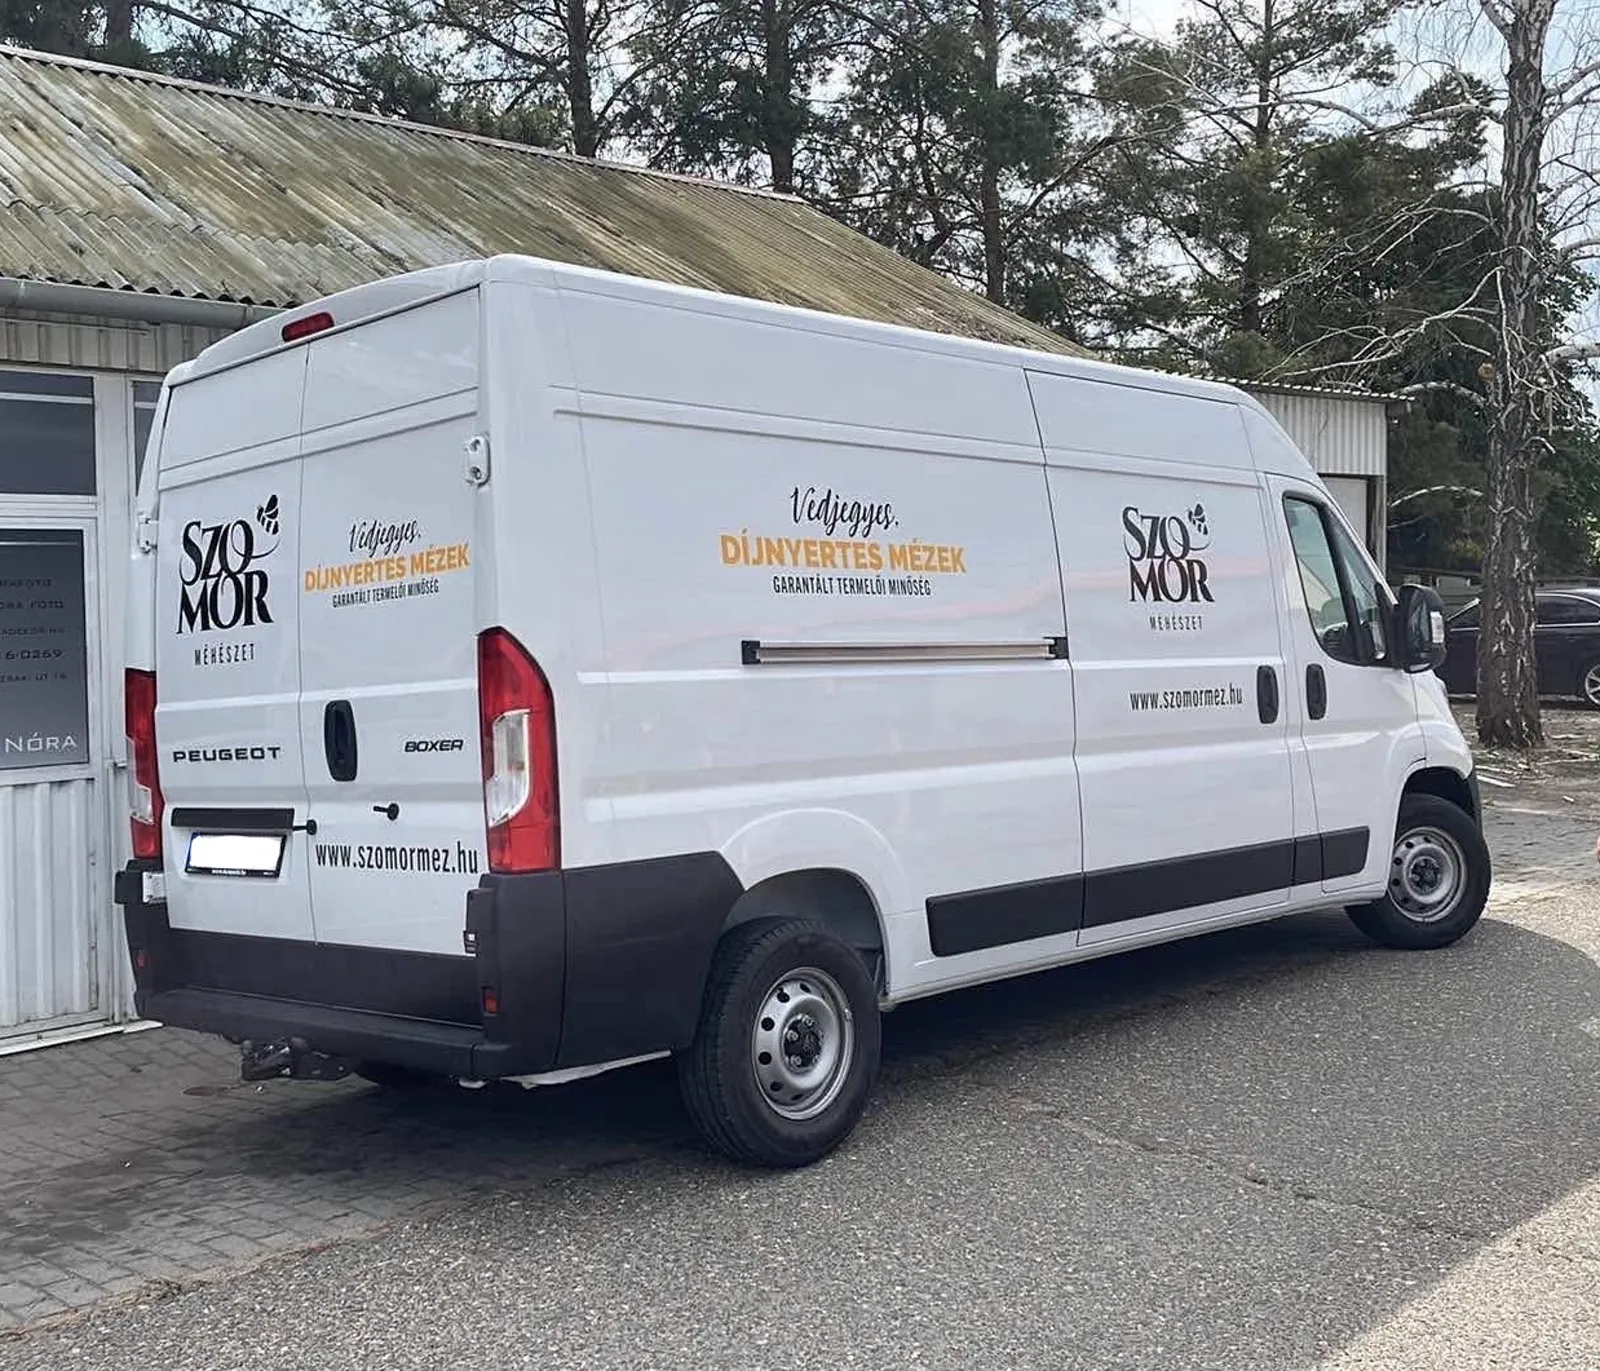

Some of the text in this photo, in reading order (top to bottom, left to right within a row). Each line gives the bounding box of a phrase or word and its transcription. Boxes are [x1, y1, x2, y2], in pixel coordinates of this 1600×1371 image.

[720, 528, 967, 574] DÍJNYERTES MÉZEK
[304, 541, 470, 592] DÍJNYERTES MÉZEK
[773, 573, 932, 596] GARANTÁLT TERMELŐI MINŐSÉG
[332, 587, 371, 608] GARANTÁLT
[194, 642, 255, 666] MÉHÉSZET
[1130, 683, 1243, 711] www.szomormez.hu
[4, 731, 78, 753] NÓRA
[404, 739, 464, 752] BOXER
[172, 747, 281, 762] PEUGEOT
[315, 840, 478, 874] www.szomormez.hu
